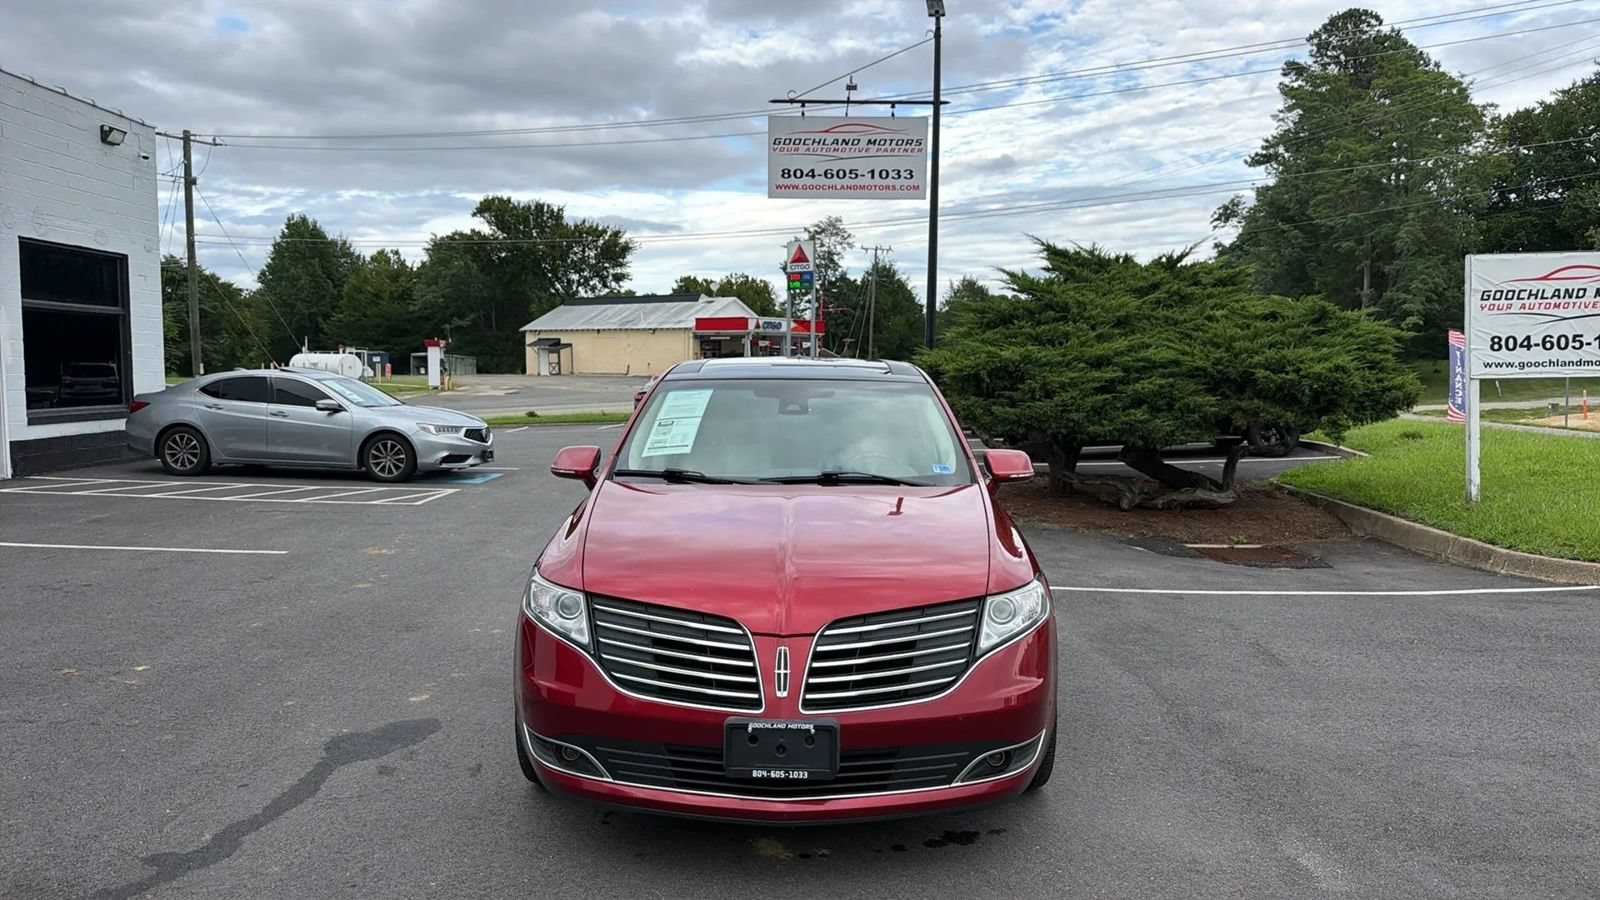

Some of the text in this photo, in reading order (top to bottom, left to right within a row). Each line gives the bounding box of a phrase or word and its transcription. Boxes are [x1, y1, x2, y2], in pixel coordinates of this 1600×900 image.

[772, 137, 924, 147] GOOCHLAND MOTORS
[804, 146, 871, 154] AUTOMOTIVE
[780, 168, 914, 180] 804-605-1033
[775, 183, 920, 192] WWW.GOOCHLANDMOTORS.COM
[1480, 288, 1587, 301] GOOCHLAND
[1480, 301, 1600, 312] YOUR AUTOMOTIVE
[752, 770, 808, 778] 804-605-1033
